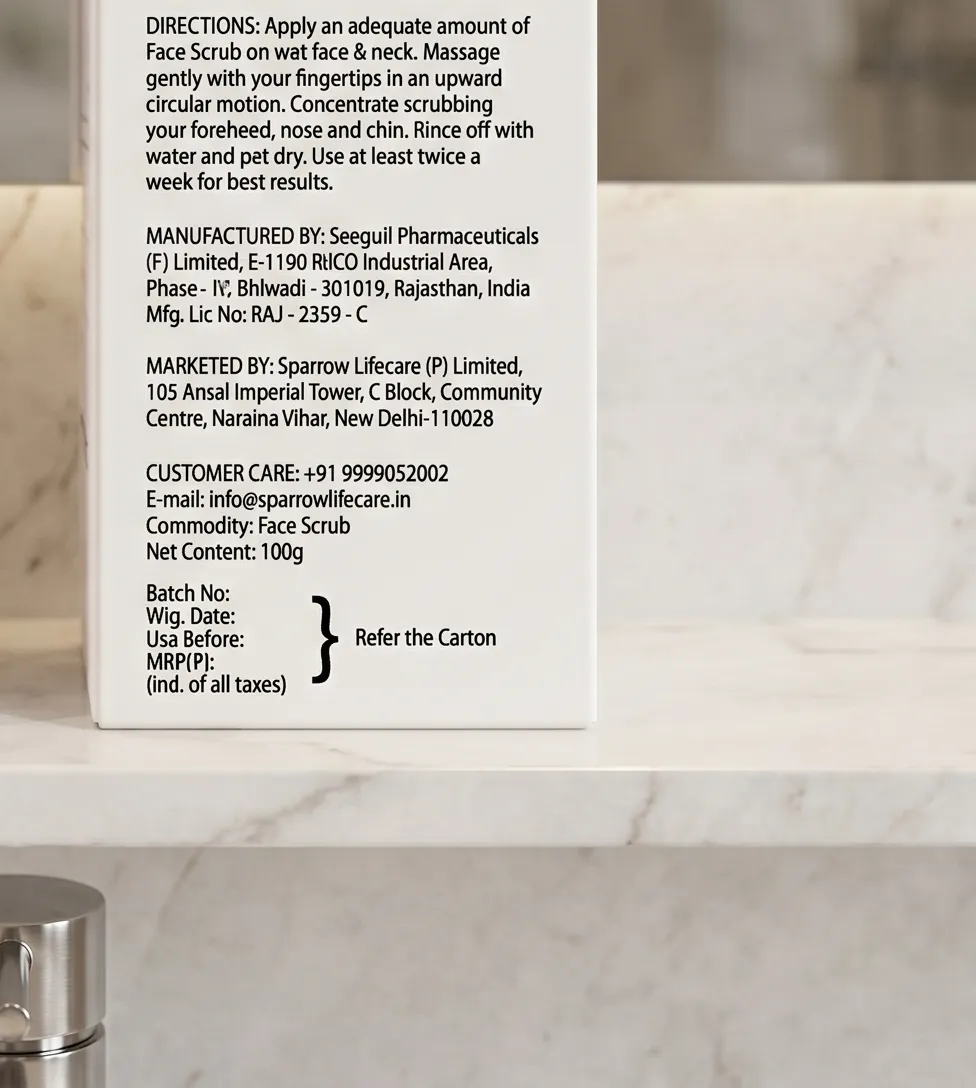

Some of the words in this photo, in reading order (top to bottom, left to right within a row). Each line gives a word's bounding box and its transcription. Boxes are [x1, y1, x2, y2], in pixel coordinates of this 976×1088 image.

[146, 16, 260, 35] DIRECTIONS:
[264, 15, 318, 40] Apply
[321, 20, 343, 35] an
[347, 15, 433, 40] adequate
[436, 17, 508, 35] amount
[511, 15, 532, 35] of
[146, 42, 186, 61] Face
[190, 41, 242, 61] Scrub
[246, 46, 270, 61] on
[311, 41, 349, 61] face
[353, 42, 367, 61] &
[371, 41, 418, 61] neck.
[423, 42, 501, 66] Massage
[145, 68, 203, 92] gently
[206, 68, 246, 87] with
[250, 73, 292, 92] your
[295, 67, 382, 92] fingertips
[386, 68, 403, 87] in
[407, 73, 430, 87] an
[435, 68, 502, 92] upward
[145, 94, 212, 113] circular
[216, 94, 286, 113] motion.
[290, 94, 399, 113] Concentrate
[403, 93, 493, 118] scrubbing
[145, 124, 187, 144] your
[280, 124, 323, 139] nose
[327, 119, 362, 139] and
[366, 119, 409, 139] chin.
[414, 120, 462, 139] Rince
[465, 119, 492, 139] off
[494, 119, 534, 139] with
[145, 148, 197, 165] water
[200, 146, 235, 165] and
[273, 146, 308, 170] dry.
[312, 146, 345, 165] Use
[348, 148, 367, 165] at
[371, 146, 414, 165] least
[417, 146, 466, 165] twice
[470, 151, 481, 165] a
[145, 171, 194, 191] week
[196, 171, 224, 191] for
[227, 171, 266, 191] best
[270, 171, 333, 191] results.
[146, 226, 295, 245] MANUFACTURED
[299, 226, 325, 245] BY:
[397, 225, 539, 245] Pharmaceuticals
[146, 356, 243, 375] MARKETED
[247, 356, 274, 375] BY:
[277, 356, 350, 380] Sparrow
[354, 355, 422, 375] Lifecare
[425, 355, 448, 378] (P)
[453, 355, 523, 378] Limited,
[147, 383, 178, 402] 105
[182, 381, 230, 401] Ansal
[234, 381, 305, 406] Imperial
[308, 382, 365, 404] Tower,
[368, 382, 381, 401] C
[385, 381, 436, 404] Block,
[440, 382, 543, 406] Community
[146, 408, 208, 430] Centre,
[212, 407, 282, 426] Naraina
[283, 407, 330, 430] Vihar,
[335, 408, 374, 428] New
[378, 407, 494, 428] Delhi-110028
[146, 463, 245, 483] CUSTOMER
[248, 463, 300, 483] CARE:
[303, 464, 335, 483] +91
[341, 463, 449, 483] 9999052002
[146, 489, 205, 508] E-mail:
[209, 488, 411, 513] info@sparrowlifecare.in
[145, 515, 254, 539] Commodity:
[258, 516, 297, 535] Face
[301, 515, 351, 535] Scrub
[146, 541, 178, 561] Net
[181, 541, 256, 561] Content:
[261, 542, 304, 566] 100g
[146, 582, 195, 602] Batch
[200, 583, 230, 603] No:
[190, 606, 236, 625] Date:
[146, 629, 179, 648] Usa
[183, 628, 245, 648] Before:
[355, 627, 401, 647] Refer
[404, 627, 434, 647] the
[438, 627, 497, 647] Carton
[188, 673, 208, 694] of
[210, 673, 230, 694] all
[234, 674, 287, 697] taxes)
